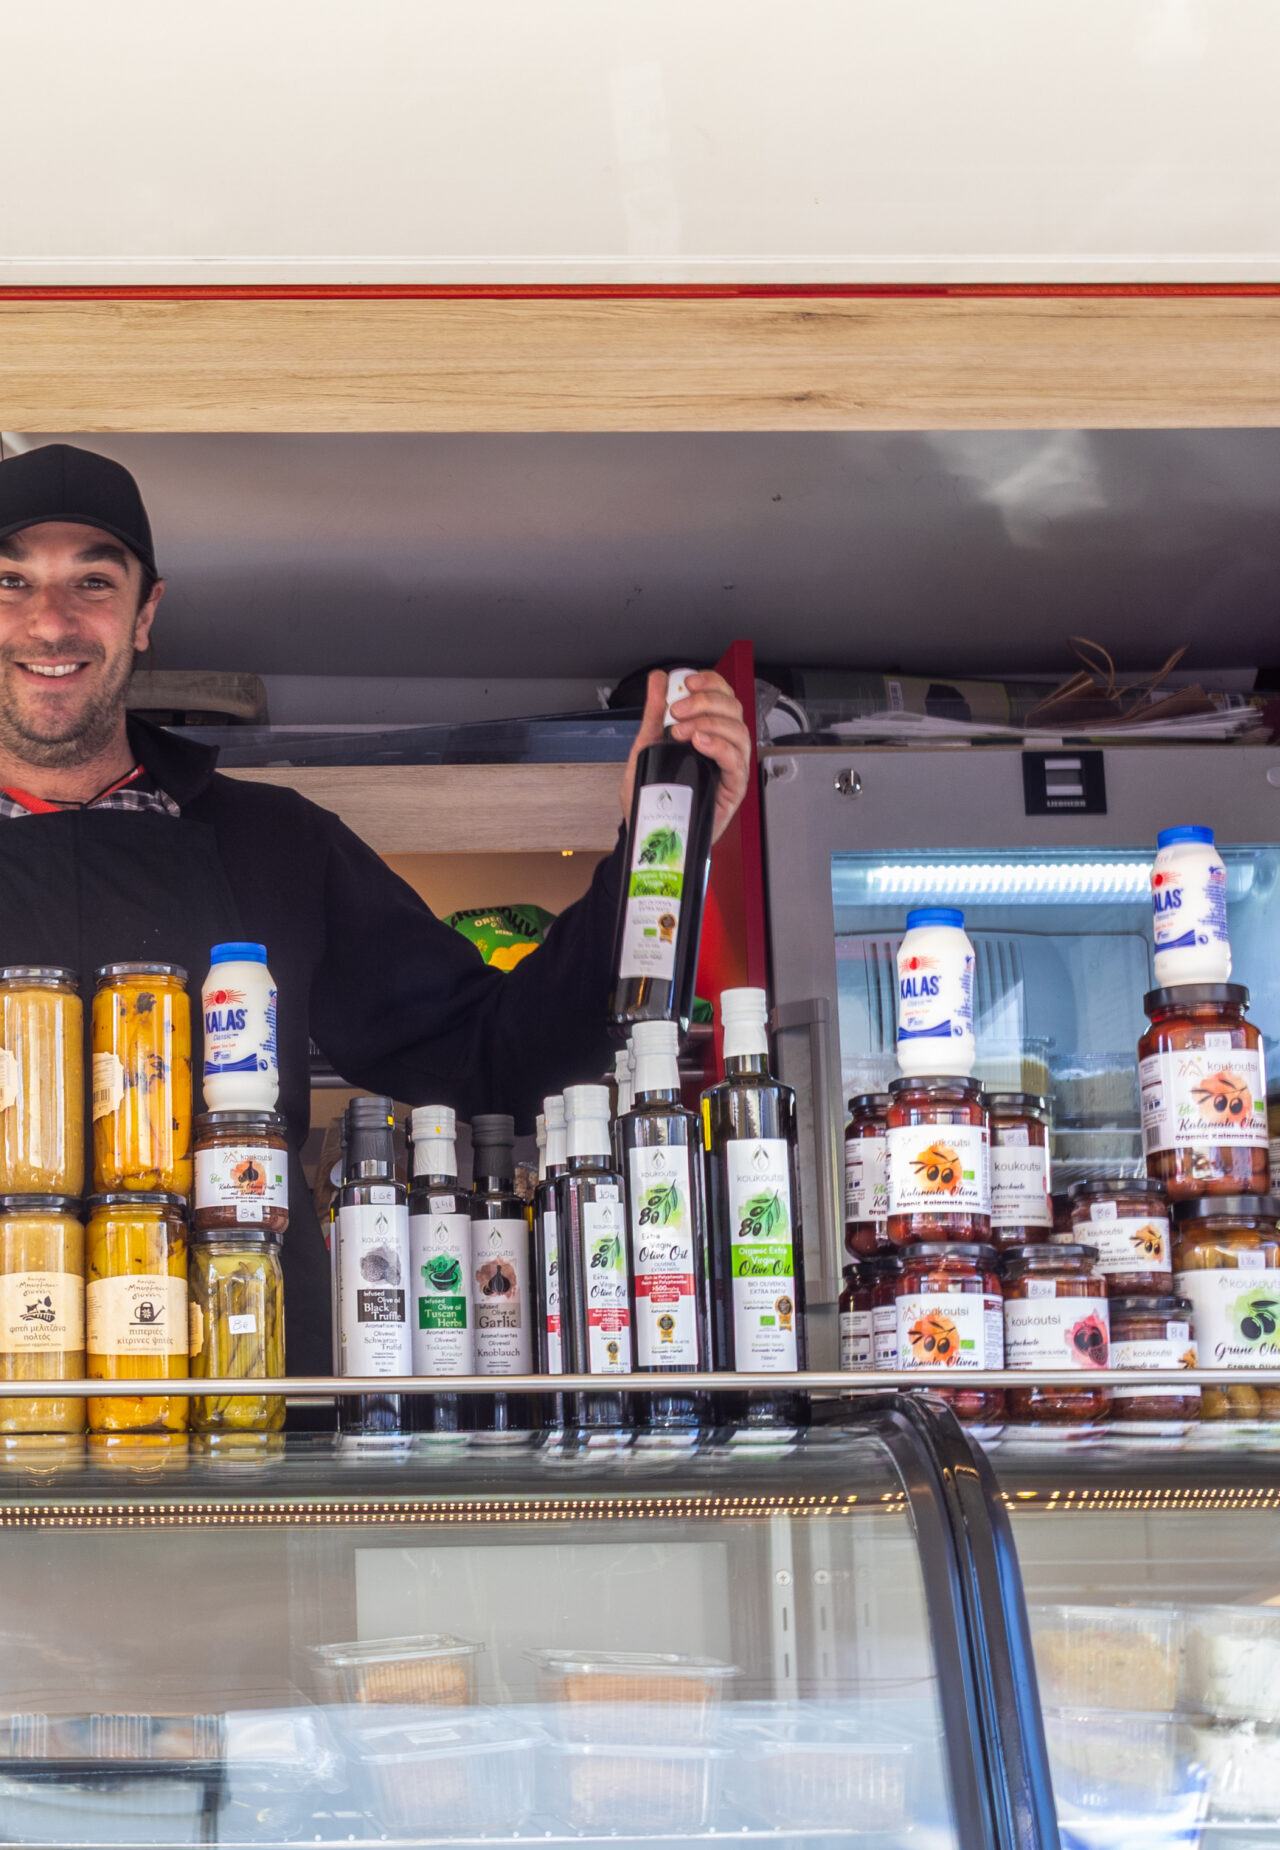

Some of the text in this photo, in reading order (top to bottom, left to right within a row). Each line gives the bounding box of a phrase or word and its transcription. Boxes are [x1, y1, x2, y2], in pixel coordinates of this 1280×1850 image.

[901, 975, 939, 1000] KALAS
[206, 1008, 246, 1034] KALAS
[1207, 1061, 1258, 1072] koukoutsi
[1179, 1117, 1235, 1132] Kalamata
[994, 1161, 1042, 1172] koukoutsi
[737, 1174, 785, 1183] koukoutsi
[901, 1185, 978, 1199] Kalamata Oliven
[639, 1245, 688, 1263] Olive Oil
[738, 1246, 788, 1256] Organic Extra
[738, 1259, 791, 1277] Olive Oil
[591, 1285, 627, 1298] Olive Oil
[363, 1302, 390, 1313] Black
[424, 1308, 457, 1318] Tuscan
[920, 1306, 970, 1317] koukoutsi
[371, 1311, 402, 1321] Truffle
[479, 1315, 517, 1328] Garlic
[1011, 1315, 1062, 1327] koukoutsi
[438, 1317, 463, 1328] Herbs
[477, 1348, 521, 1358] Knoblauch
[901, 1355, 980, 1369] Kalamata Oliven
